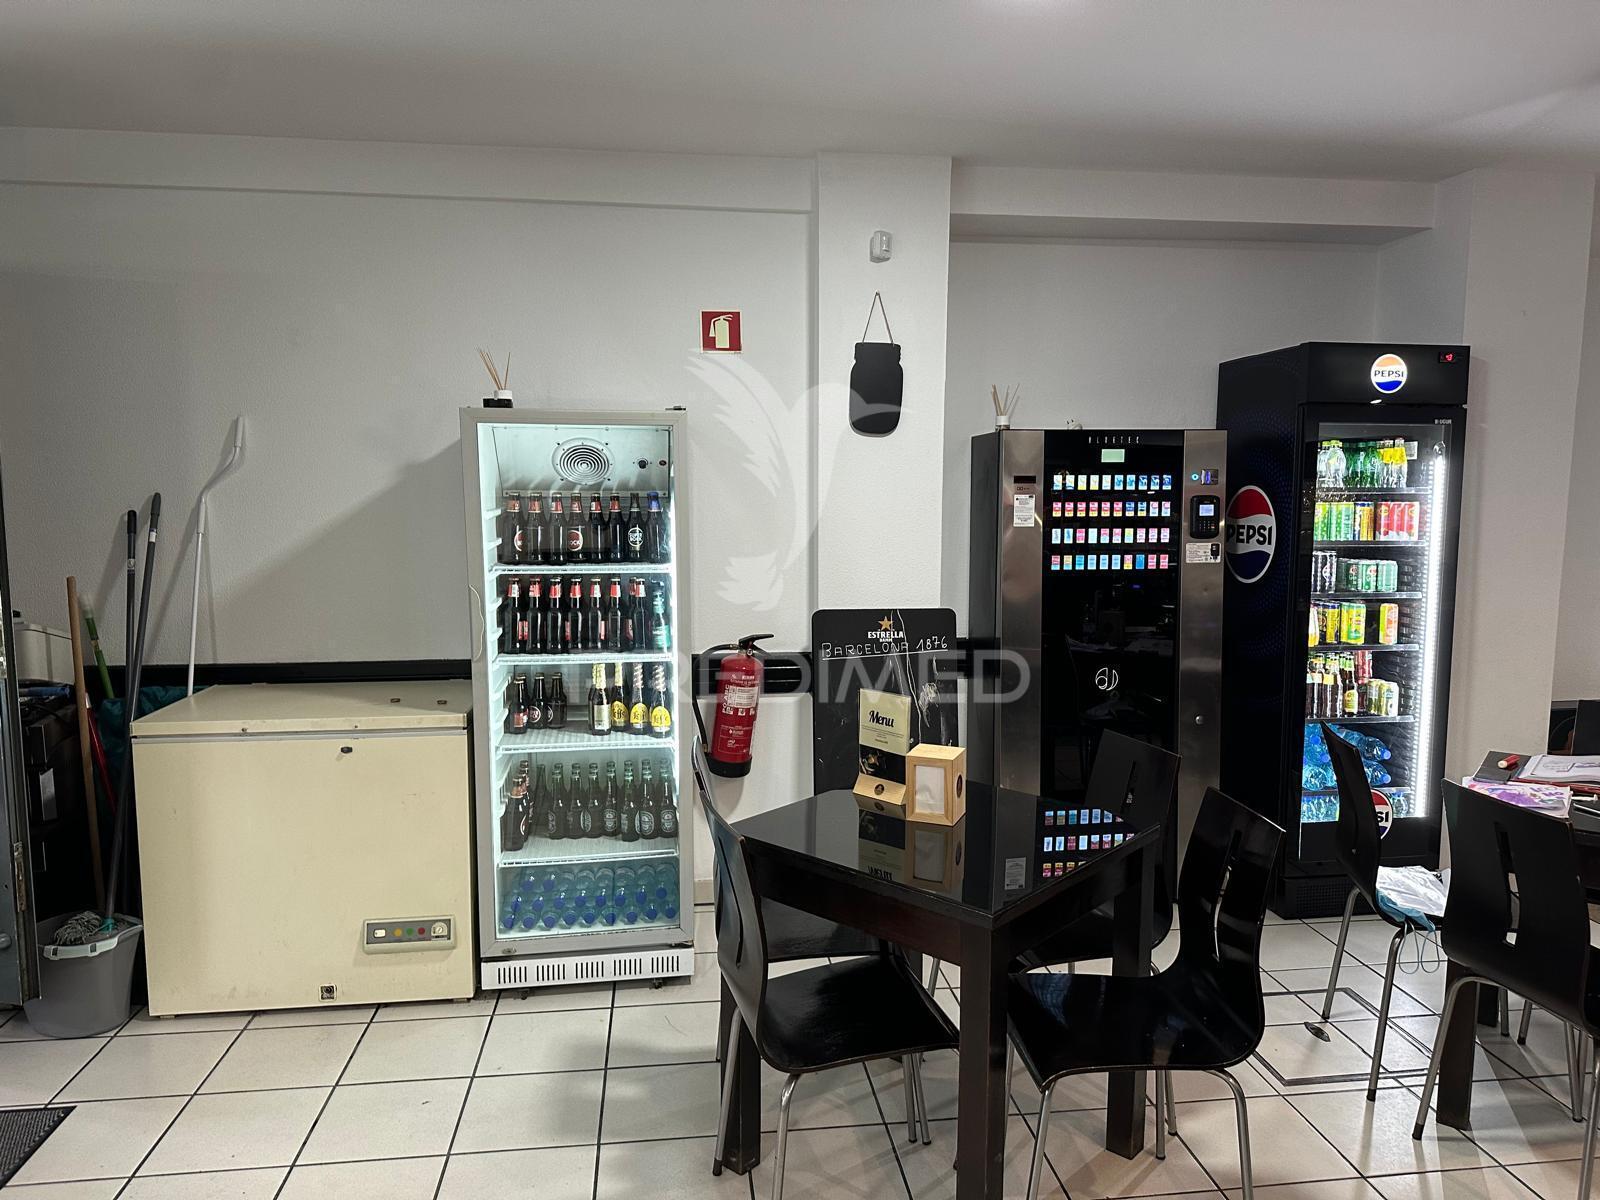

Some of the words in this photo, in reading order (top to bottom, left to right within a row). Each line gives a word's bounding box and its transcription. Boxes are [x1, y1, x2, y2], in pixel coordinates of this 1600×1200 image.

[1374, 369, 1404, 378] PEPSI
[1226, 524, 1273, 546] PEPSI
[867, 630, 904, 639] ESTRELLA
[821, 642, 909, 658] BARCELONA
[916, 636, 948, 652] 1876
[868, 709, 895, 728] Menu
